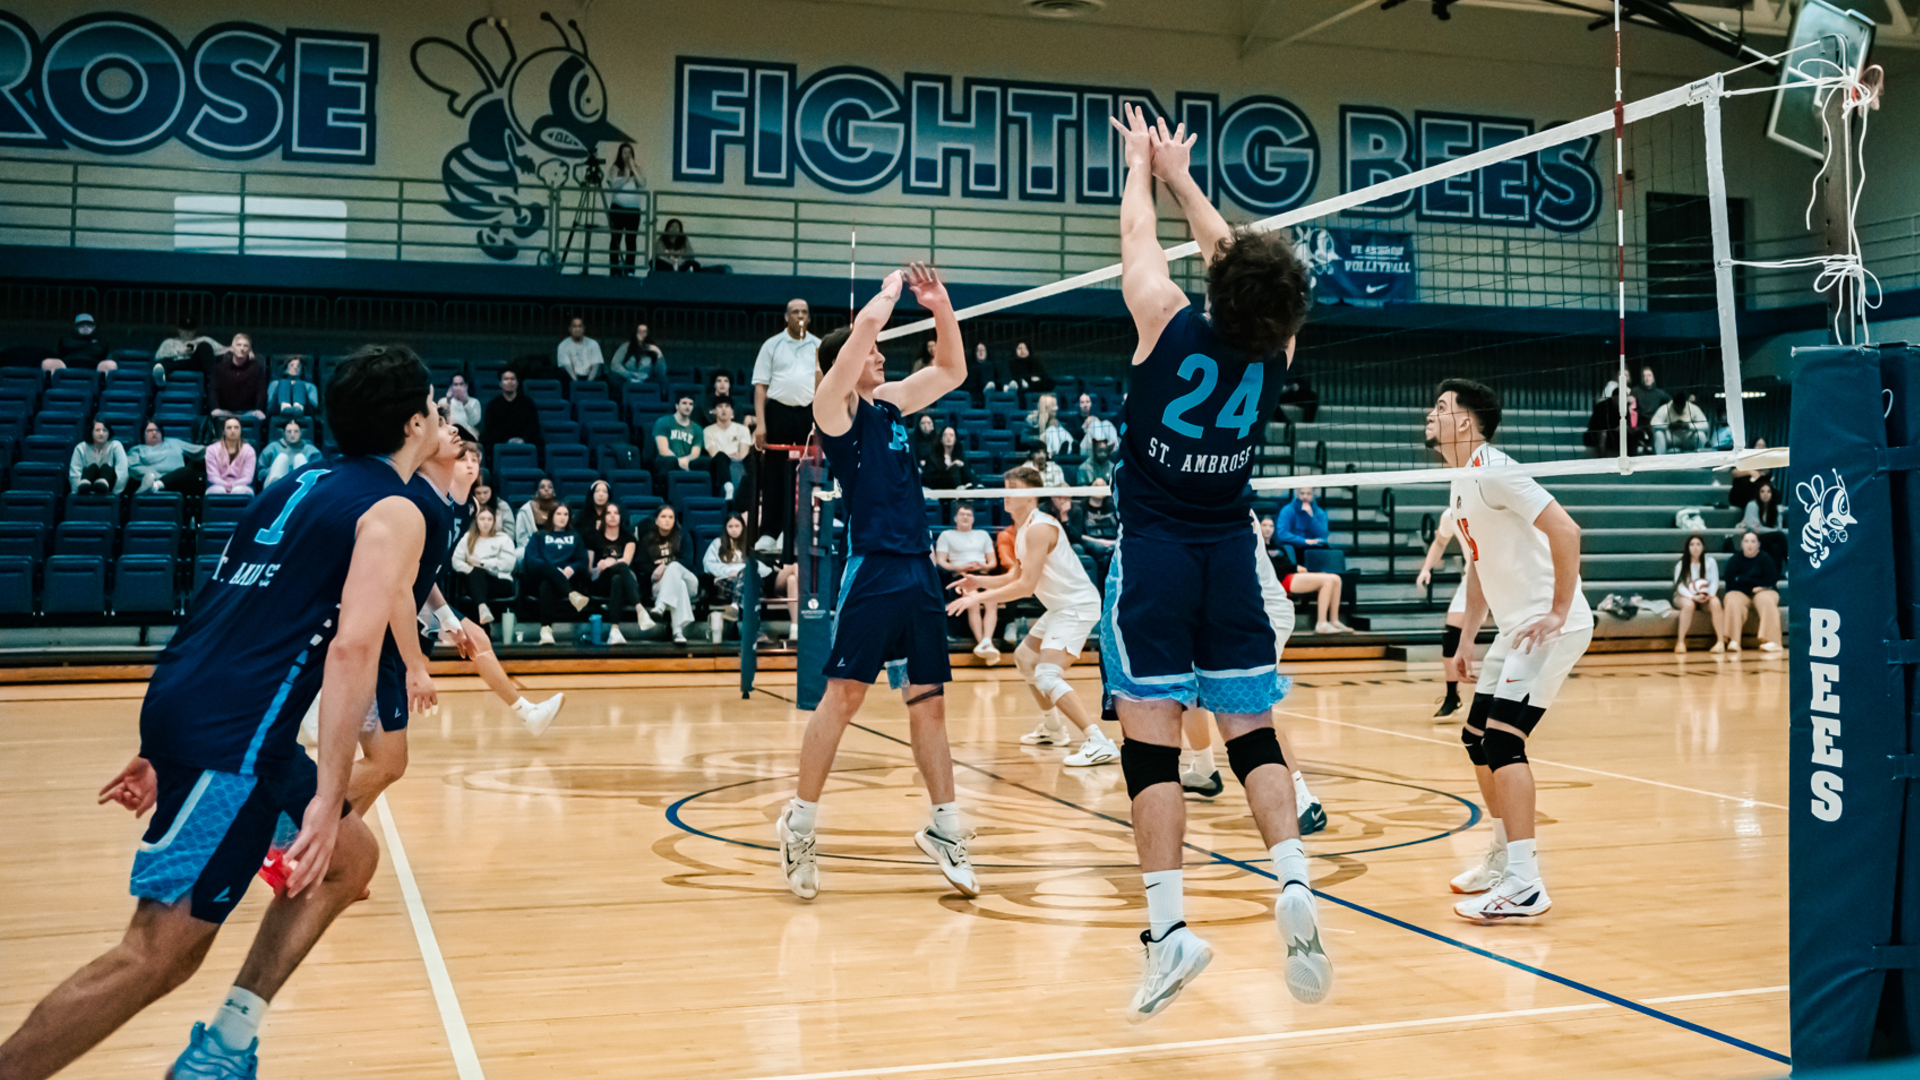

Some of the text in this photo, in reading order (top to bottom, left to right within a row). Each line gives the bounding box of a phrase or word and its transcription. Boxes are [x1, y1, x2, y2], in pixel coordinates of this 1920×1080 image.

[673, 55, 1602, 233] FIGHTING BEES
[1161, 353, 1263, 439] 24
[1148, 436, 1171, 468] ST.
[253, 468, 333, 546] 1
[1808, 607, 1844, 823] BEES
